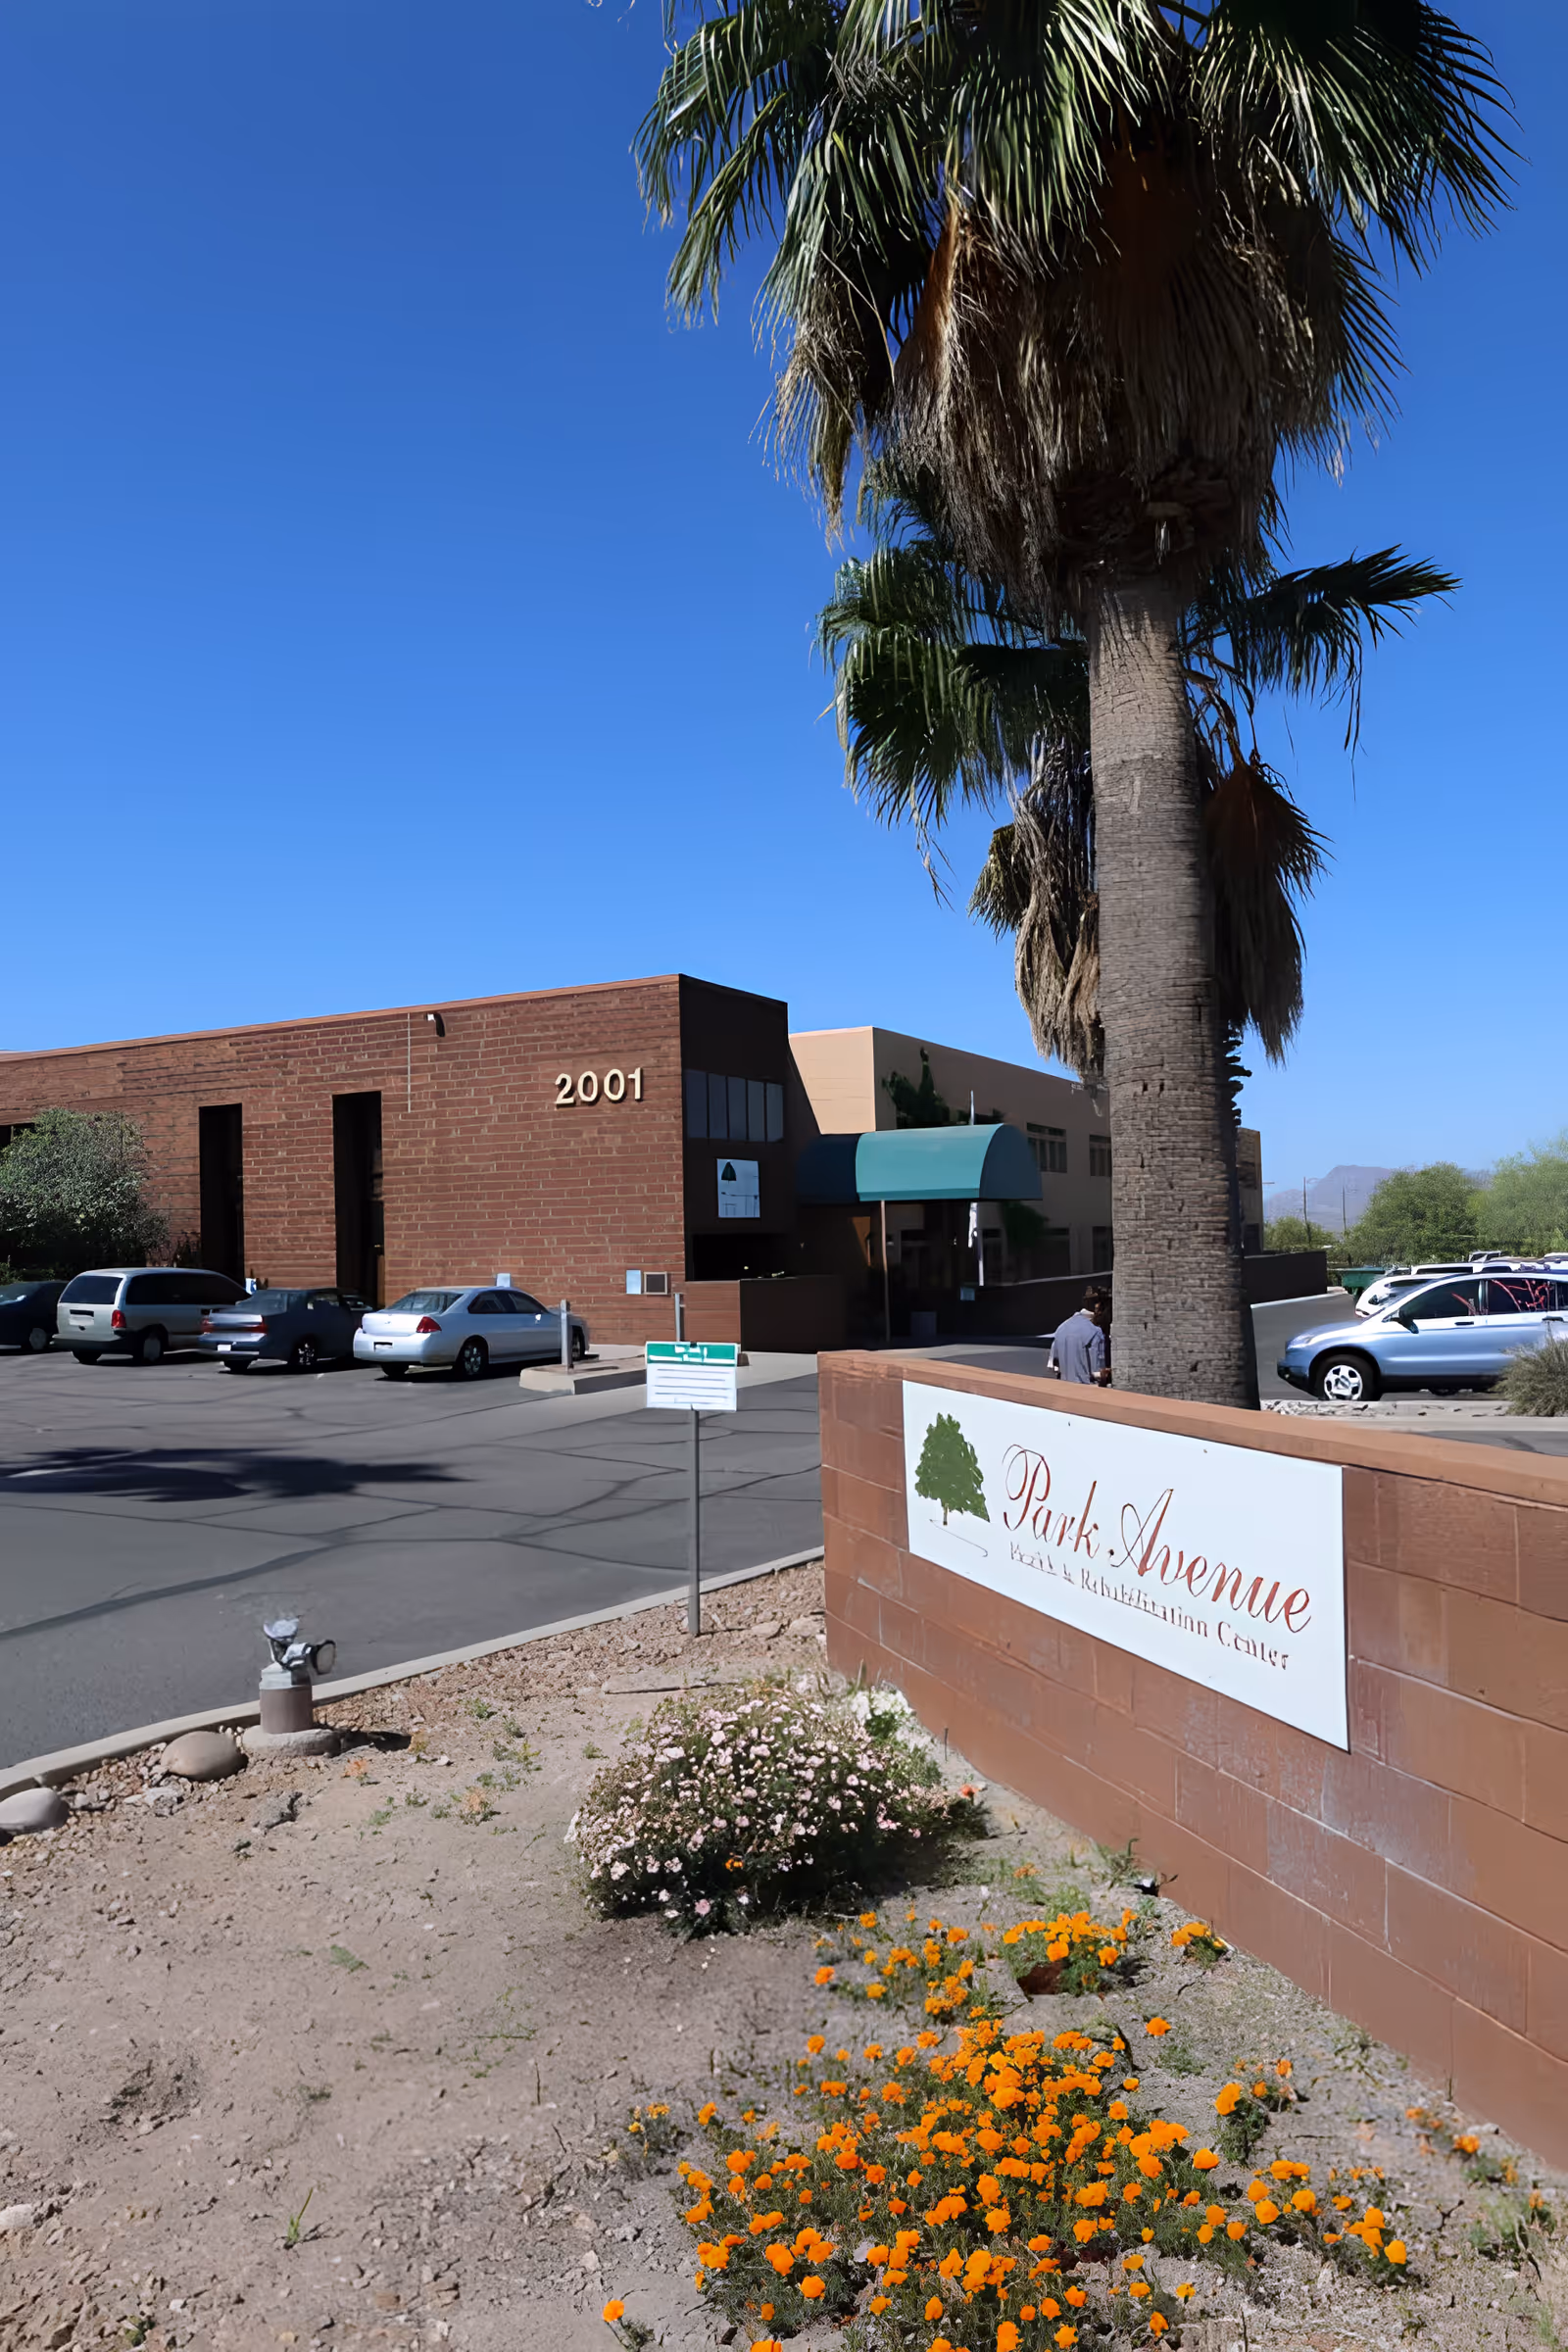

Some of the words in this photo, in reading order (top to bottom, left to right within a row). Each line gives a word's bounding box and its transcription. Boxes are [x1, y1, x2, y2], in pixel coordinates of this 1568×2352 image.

[554, 1067, 642, 1104] 2001
[1002, 1444, 1101, 1559] Park
[1107, 1488, 1312, 1634] Avenue
